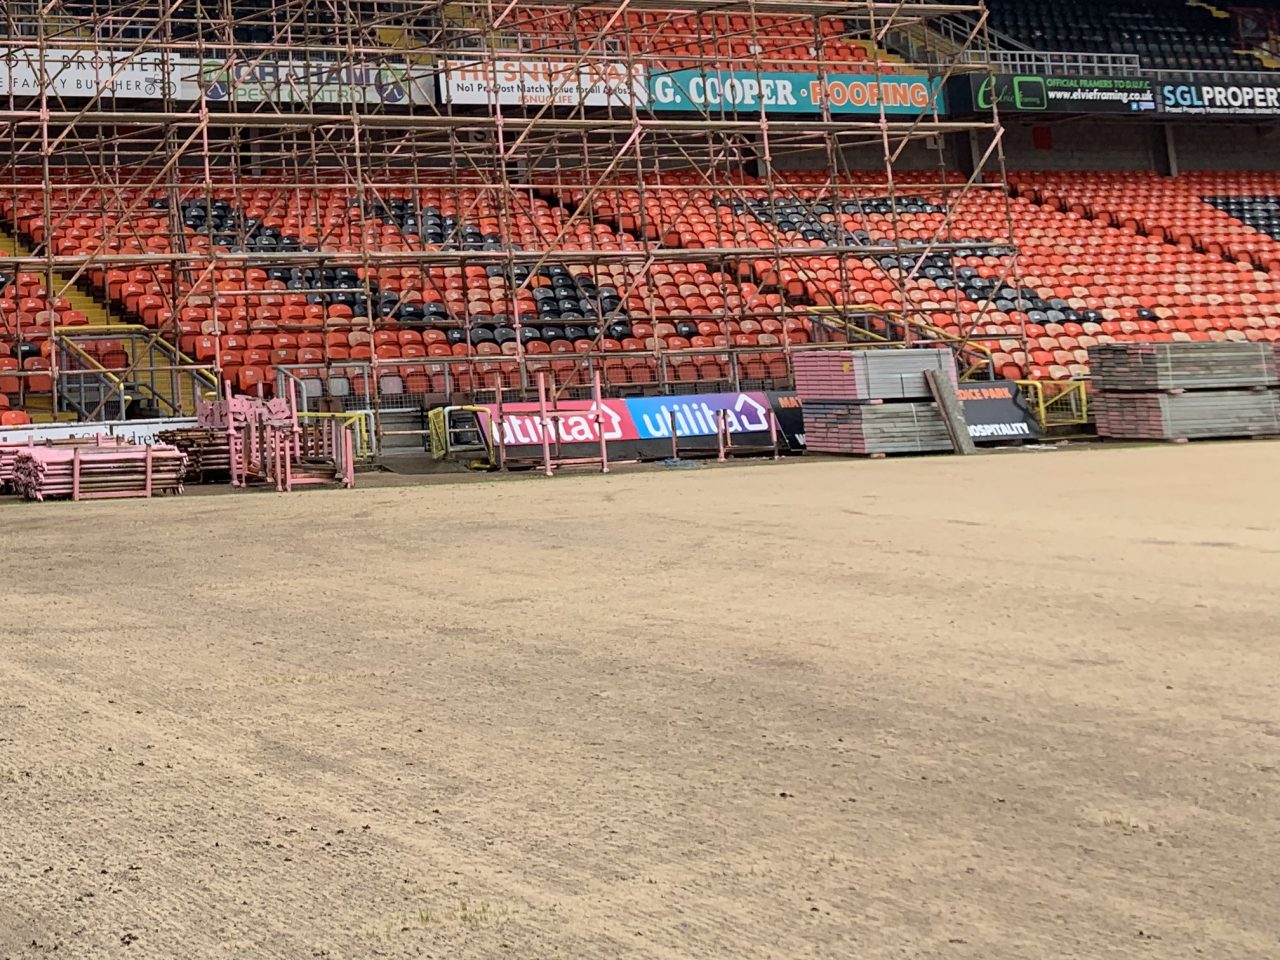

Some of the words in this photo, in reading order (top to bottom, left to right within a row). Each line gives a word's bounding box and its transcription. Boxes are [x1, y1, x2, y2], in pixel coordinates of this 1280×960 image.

[13, 78, 68, 89] FAMY
[76, 79, 142, 92] BUCHER
[1046, 78, 1078, 88] OFFICIAL
[689, 76, 797, 106] COOPER
[809, 80, 929, 108] ROOFING
[1047, 89, 1153, 103] www.elvieframing.co.uk
[983, 387, 1013, 399] PARK
[643, 402, 742, 438] utilita
